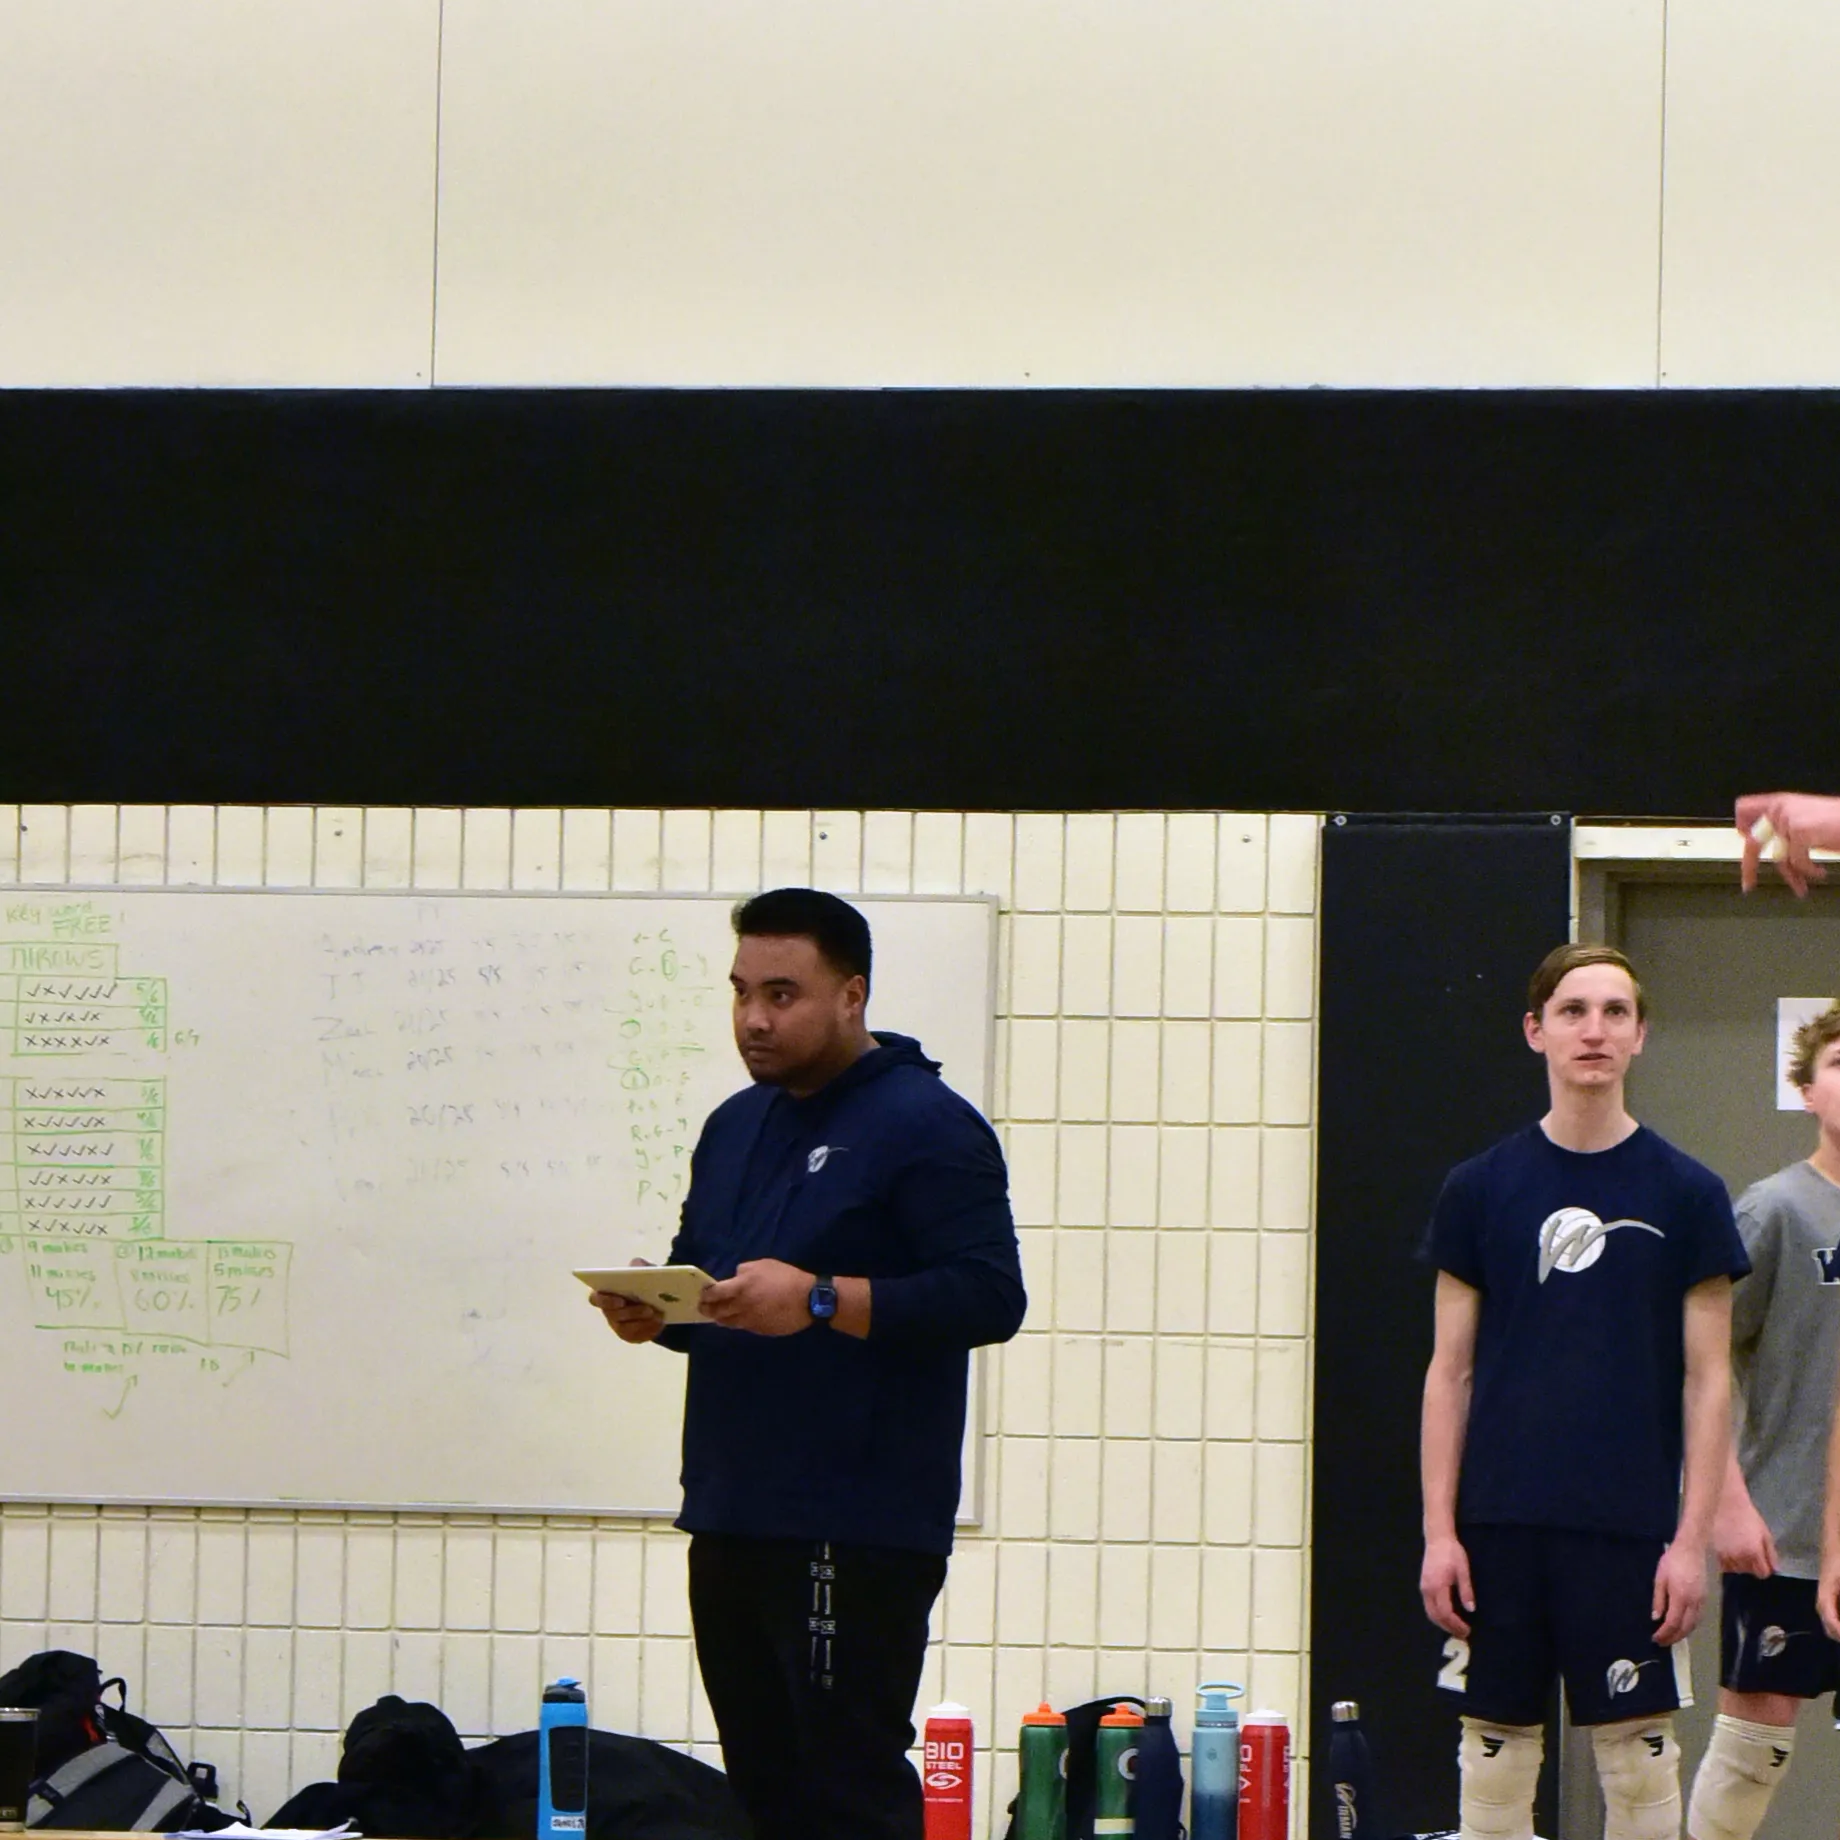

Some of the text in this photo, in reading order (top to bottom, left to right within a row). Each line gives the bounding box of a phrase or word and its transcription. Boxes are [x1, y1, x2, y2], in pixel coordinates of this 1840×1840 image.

[1437, 1637, 1470, 1693] 2
[926, 1741, 964, 1759] BIO
[926, 1761, 964, 1770] STEEL
